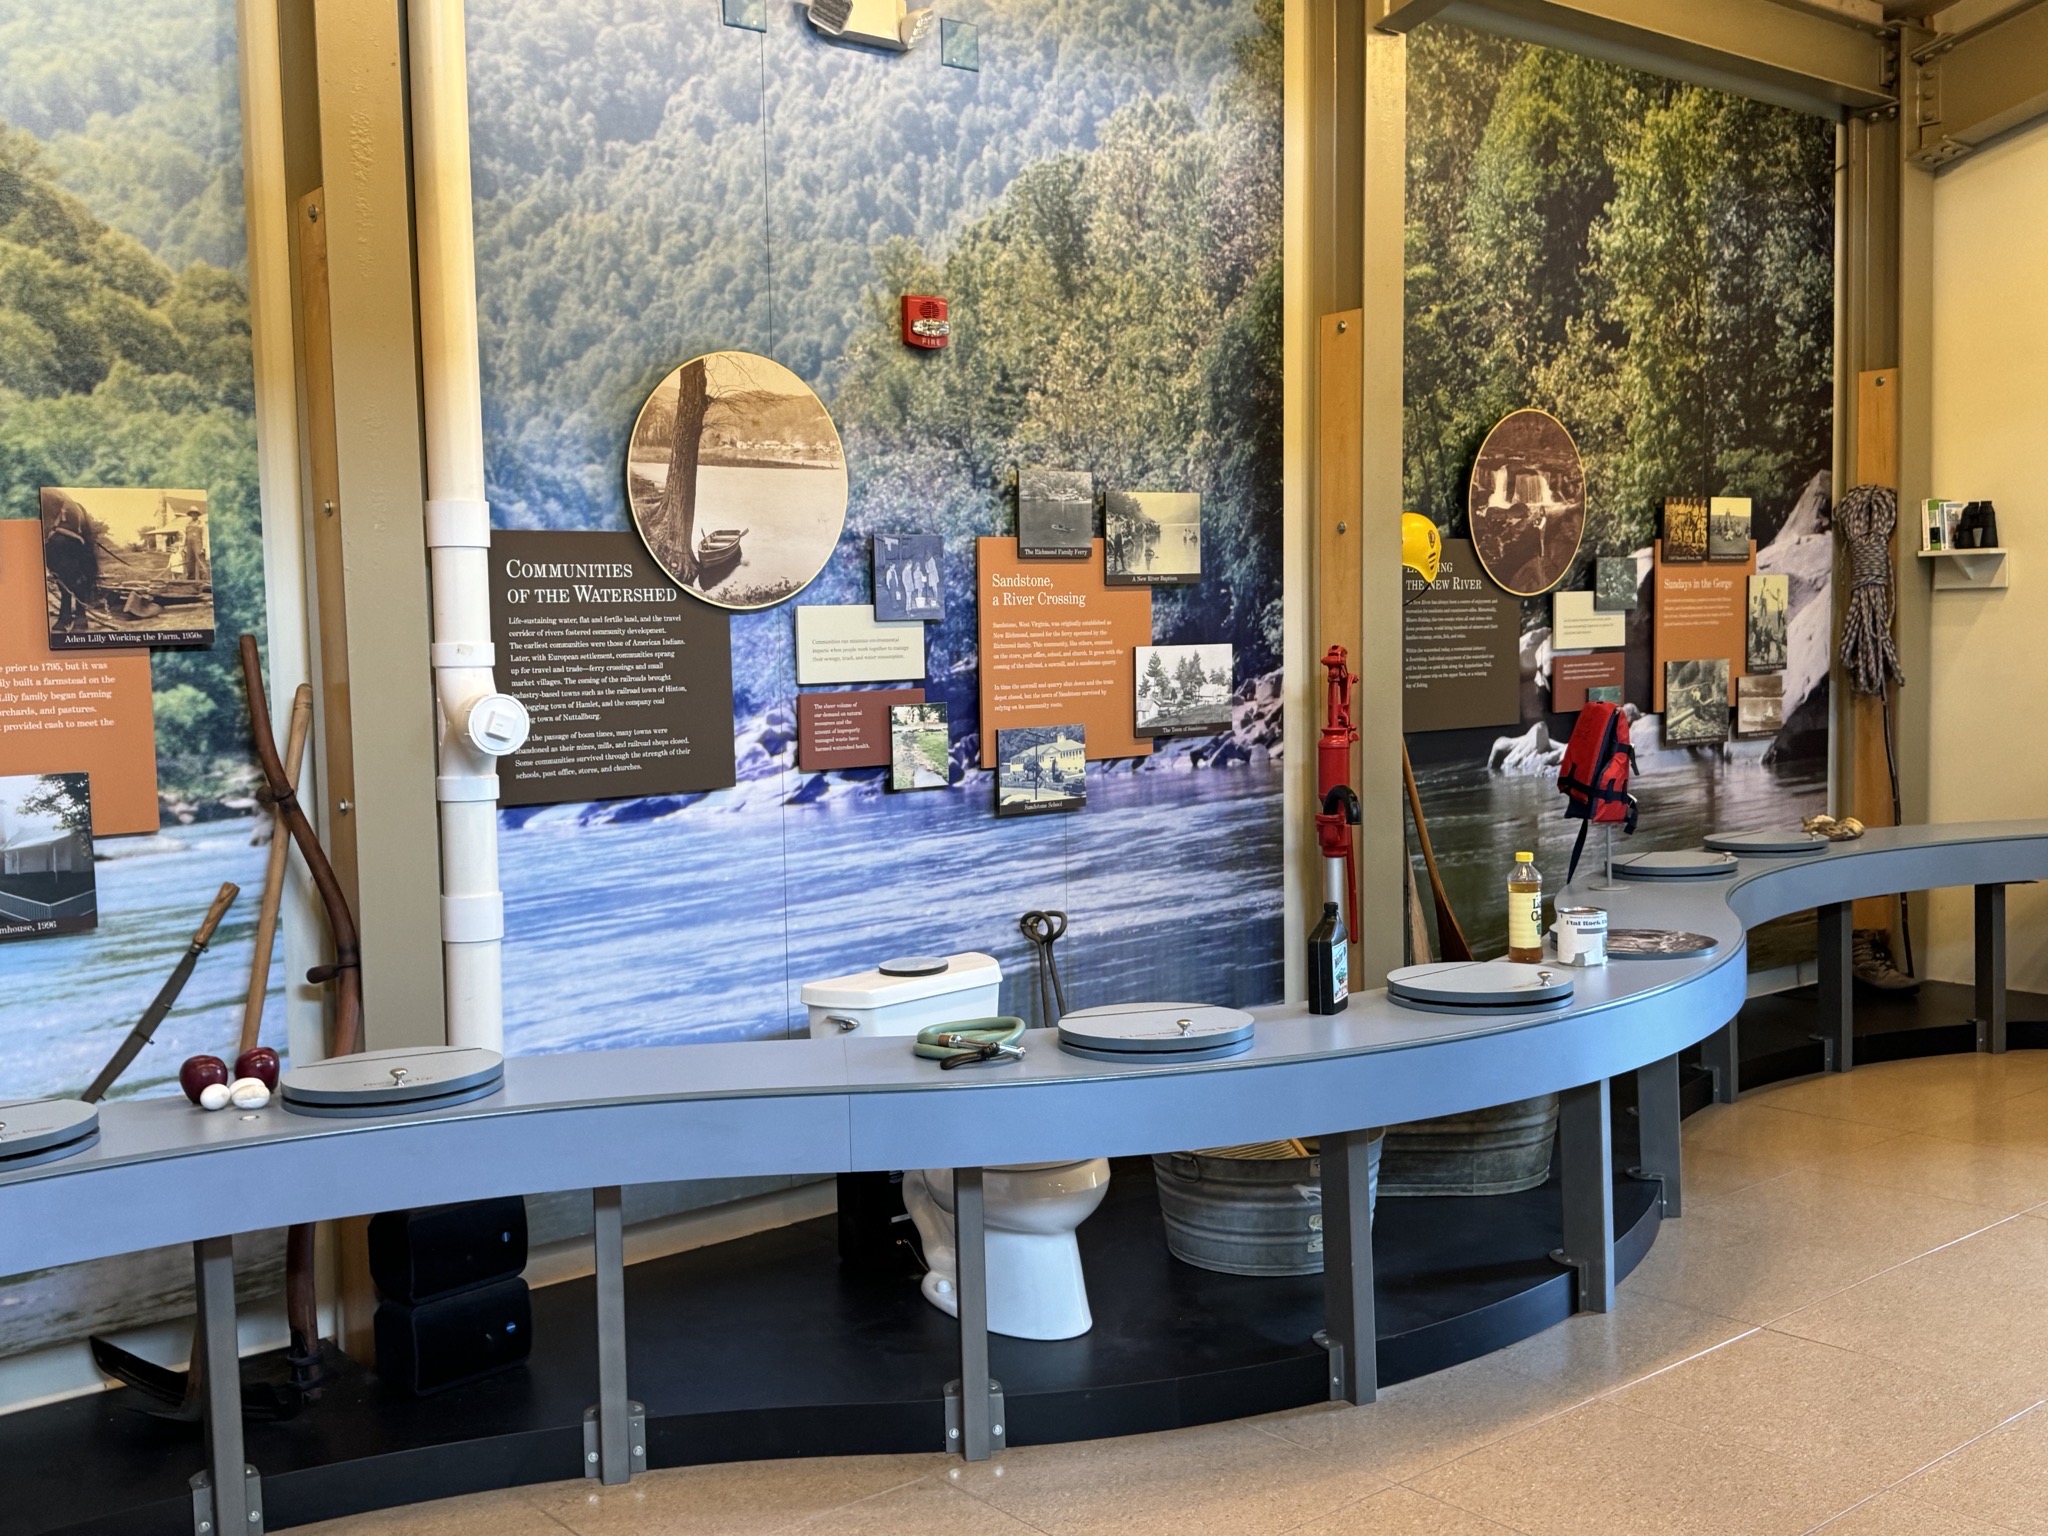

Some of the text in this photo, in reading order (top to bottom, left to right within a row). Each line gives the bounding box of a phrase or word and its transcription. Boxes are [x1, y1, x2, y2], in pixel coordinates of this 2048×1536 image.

[506, 559, 632, 578] COMMUNITIES
[992, 573, 1053, 588] Sandstone,
[1406, 577, 1482, 590] THE NEW RIVER
[1664, 578, 1733, 592] Sundays in the Gorge
[507, 584, 677, 604] OF THE WATERSHED
[992, 590, 1086, 608] a River Crossing
[509, 617, 557, 627] Life-sustaining
[558, 617, 578, 625] water,
[65, 635, 86, 643] Aden
[88, 634, 106, 644] Lilly
[108, 633, 141, 644] Working
[143, 633, 156, 641] the
[182, 631, 202, 639] 1950s
[592, 628, 626, 637] community
[627, 627, 667, 637] development.
[510, 655, 531, 664] Later,
[548, 653, 579, 663] European
[580, 652, 615, 661] settlement,
[616, 651, 654, 659] communities
[5, 663, 28, 675] prior
[29, 663, 39, 672] to
[65, 662, 80, 670] but
[82, 662, 89, 670] it
[606, 664, 634, 673] crossings
[13, 678, 34, 687] built
[43, 676, 87, 686] farmstead
[101, 675, 115, 683] the
[536, 678, 563, 688] villages.
[578, 677, 600, 686] coming
[648, 674, 671, 684] brought
[21, 692, 48, 703] family
[50, 690, 76, 702] began
[78, 689, 112, 701] farming
[40, 706, 56, 715] and
[58, 704, 97, 716] pastures.
[576, 700, 600, 710] Hamlet,
[625, 700, 652, 708] company
[563, 713, 601, 723] Nuttallburg.
[4, 721, 42, 733] provided
[44, 720, 64, 729] cash
[65, 719, 75, 728] to
[77, 718, 98, 727] meet
[100, 717, 114, 726] the
[544, 735, 569, 743] passage
[596, 730, 615, 739] times,
[576, 743, 596, 752] mines,
[628, 740, 651, 748] railroad
[652, 739, 669, 748] shops
[670, 737, 690, 745] closed.
[515, 759, 534, 767] Some
[535, 756, 575, 766] communities
[577, 754, 604, 763] survived
[605, 752, 630, 763] through
[642, 749, 668, 760] strength
[516, 771, 542, 781] schools,
[542, 770, 556, 780] post
[558, 768, 577, 778] office,
[578, 766, 600, 776] stores,
[613, 763, 642, 772] churches.
[38, 921, 57, 930] 1996
